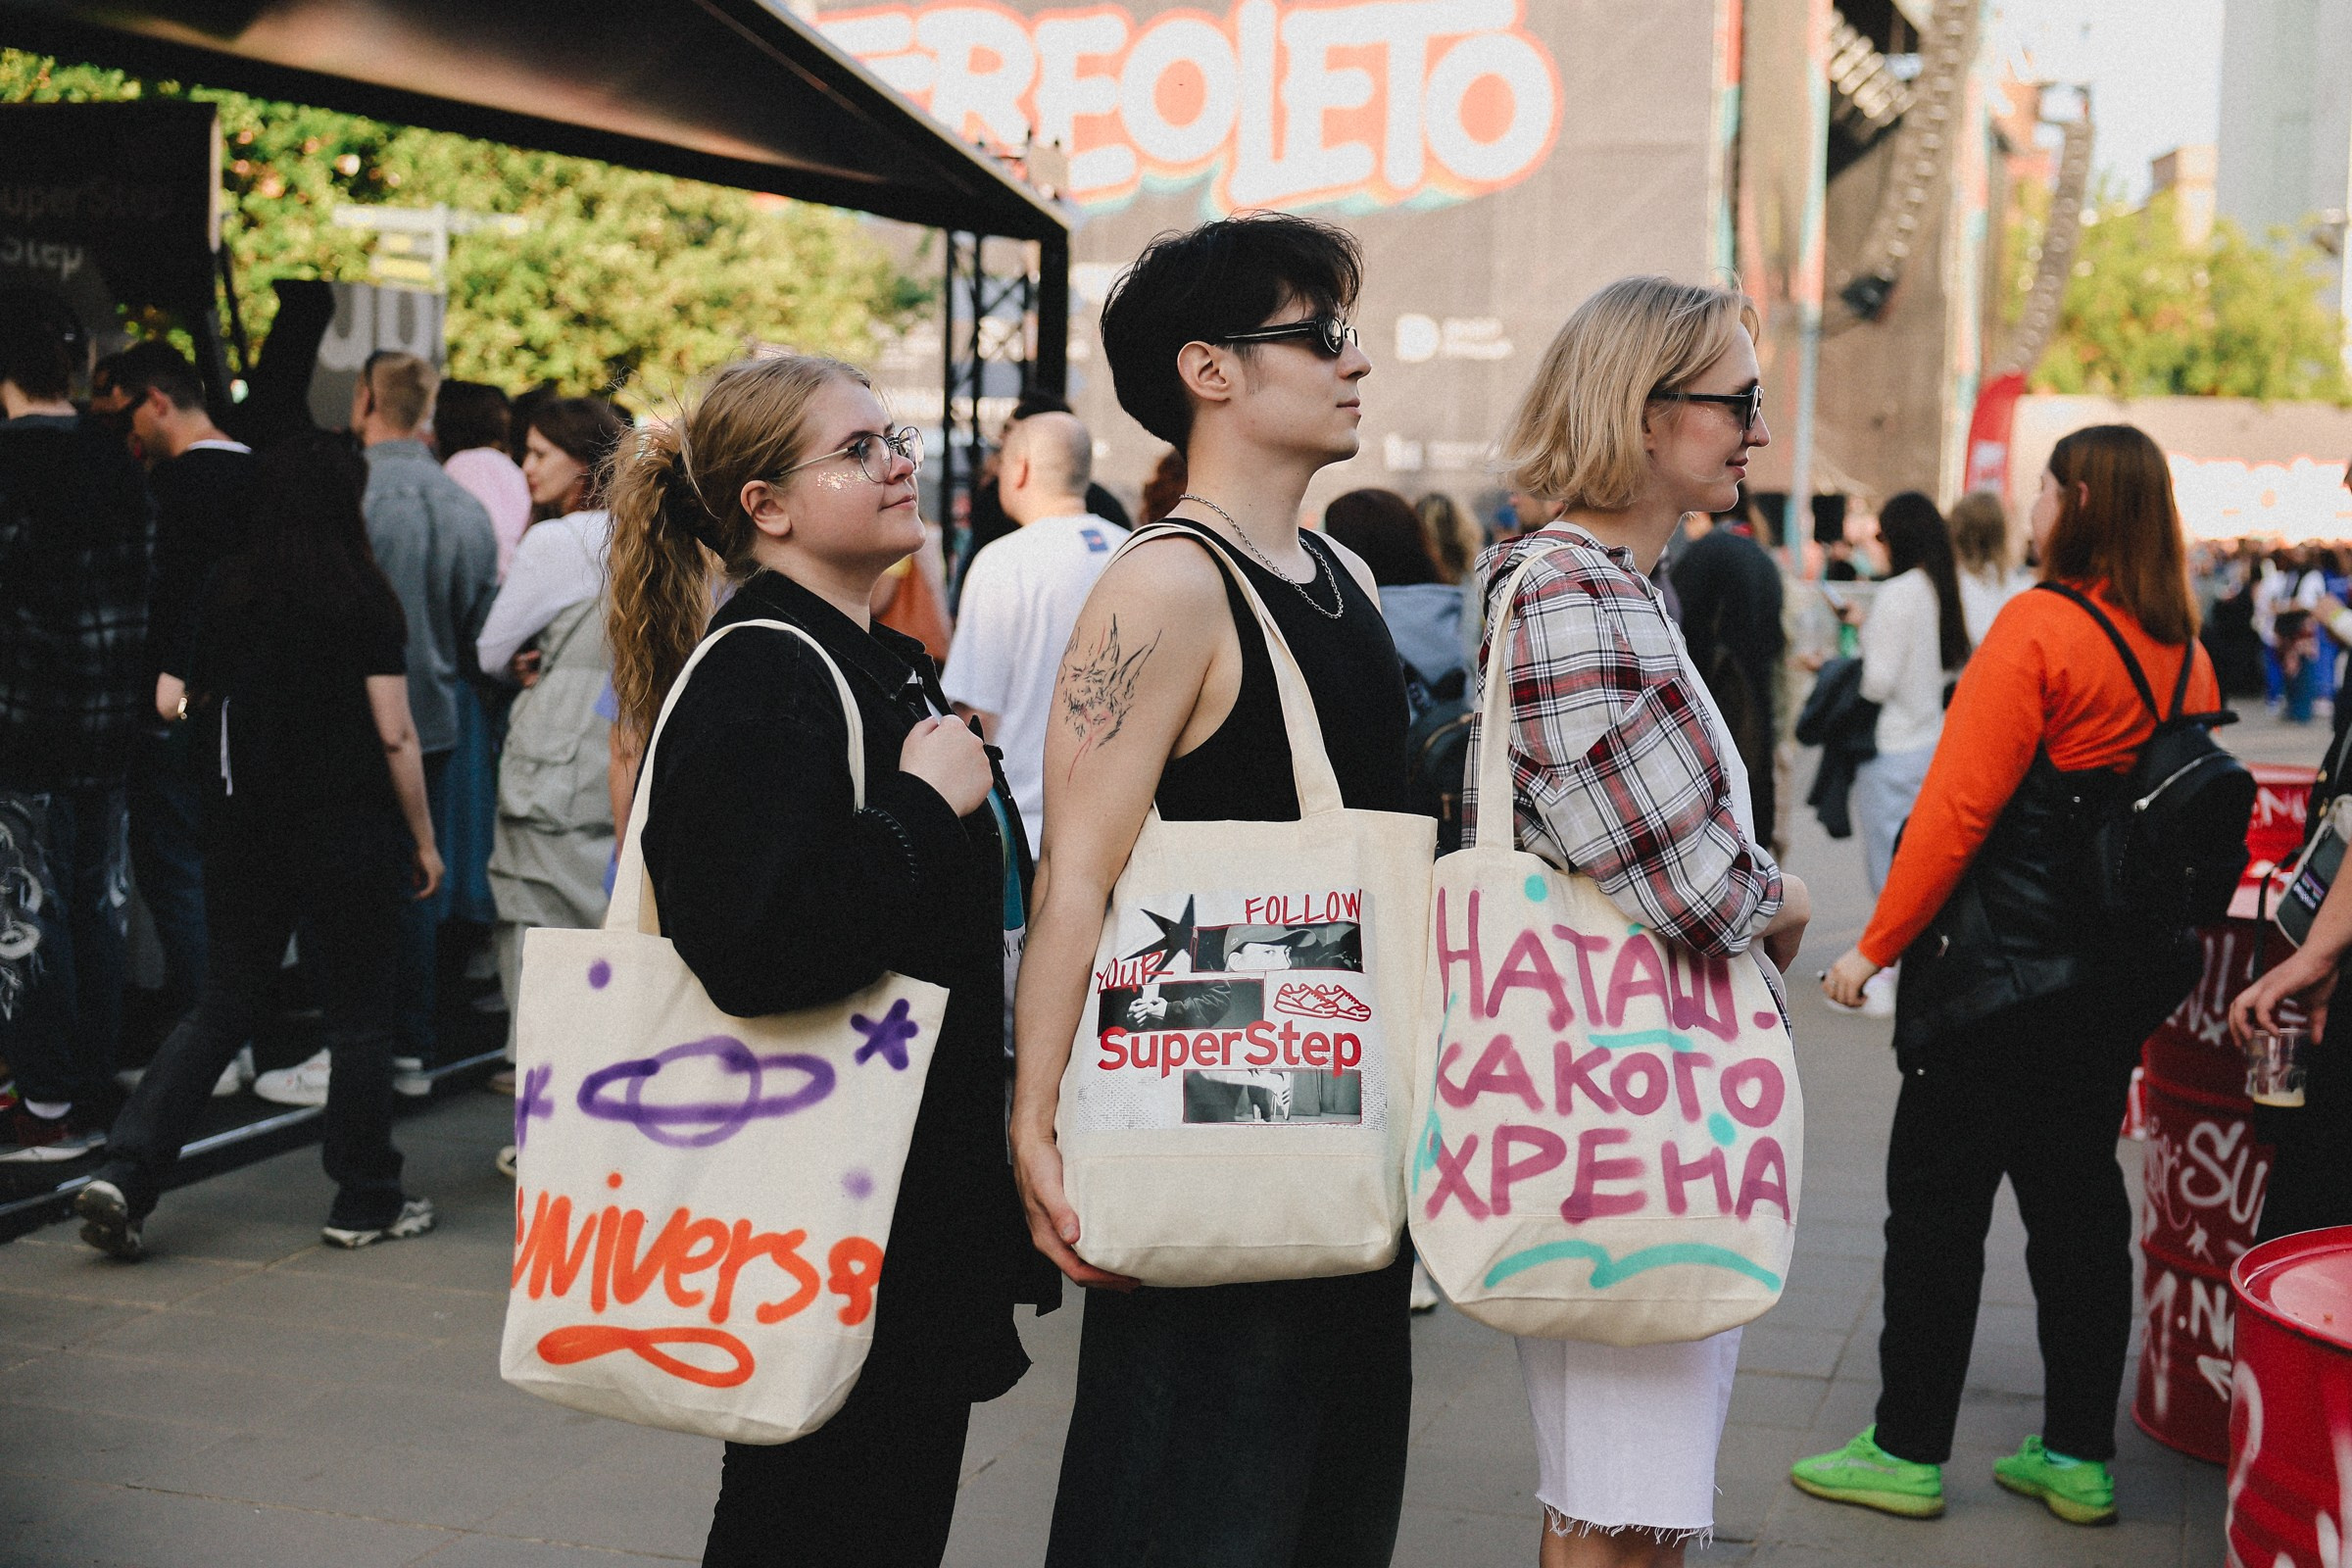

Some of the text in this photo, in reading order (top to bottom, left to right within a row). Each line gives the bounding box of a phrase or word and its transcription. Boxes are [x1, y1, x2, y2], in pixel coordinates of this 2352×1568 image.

[1245, 889, 1362, 925] FOLLOW
[1096, 951, 1174, 995] YOUR
[1097, 1019, 1362, 1079] SuperStep
[1425, 1124, 1791, 1225] ХРЕНА
